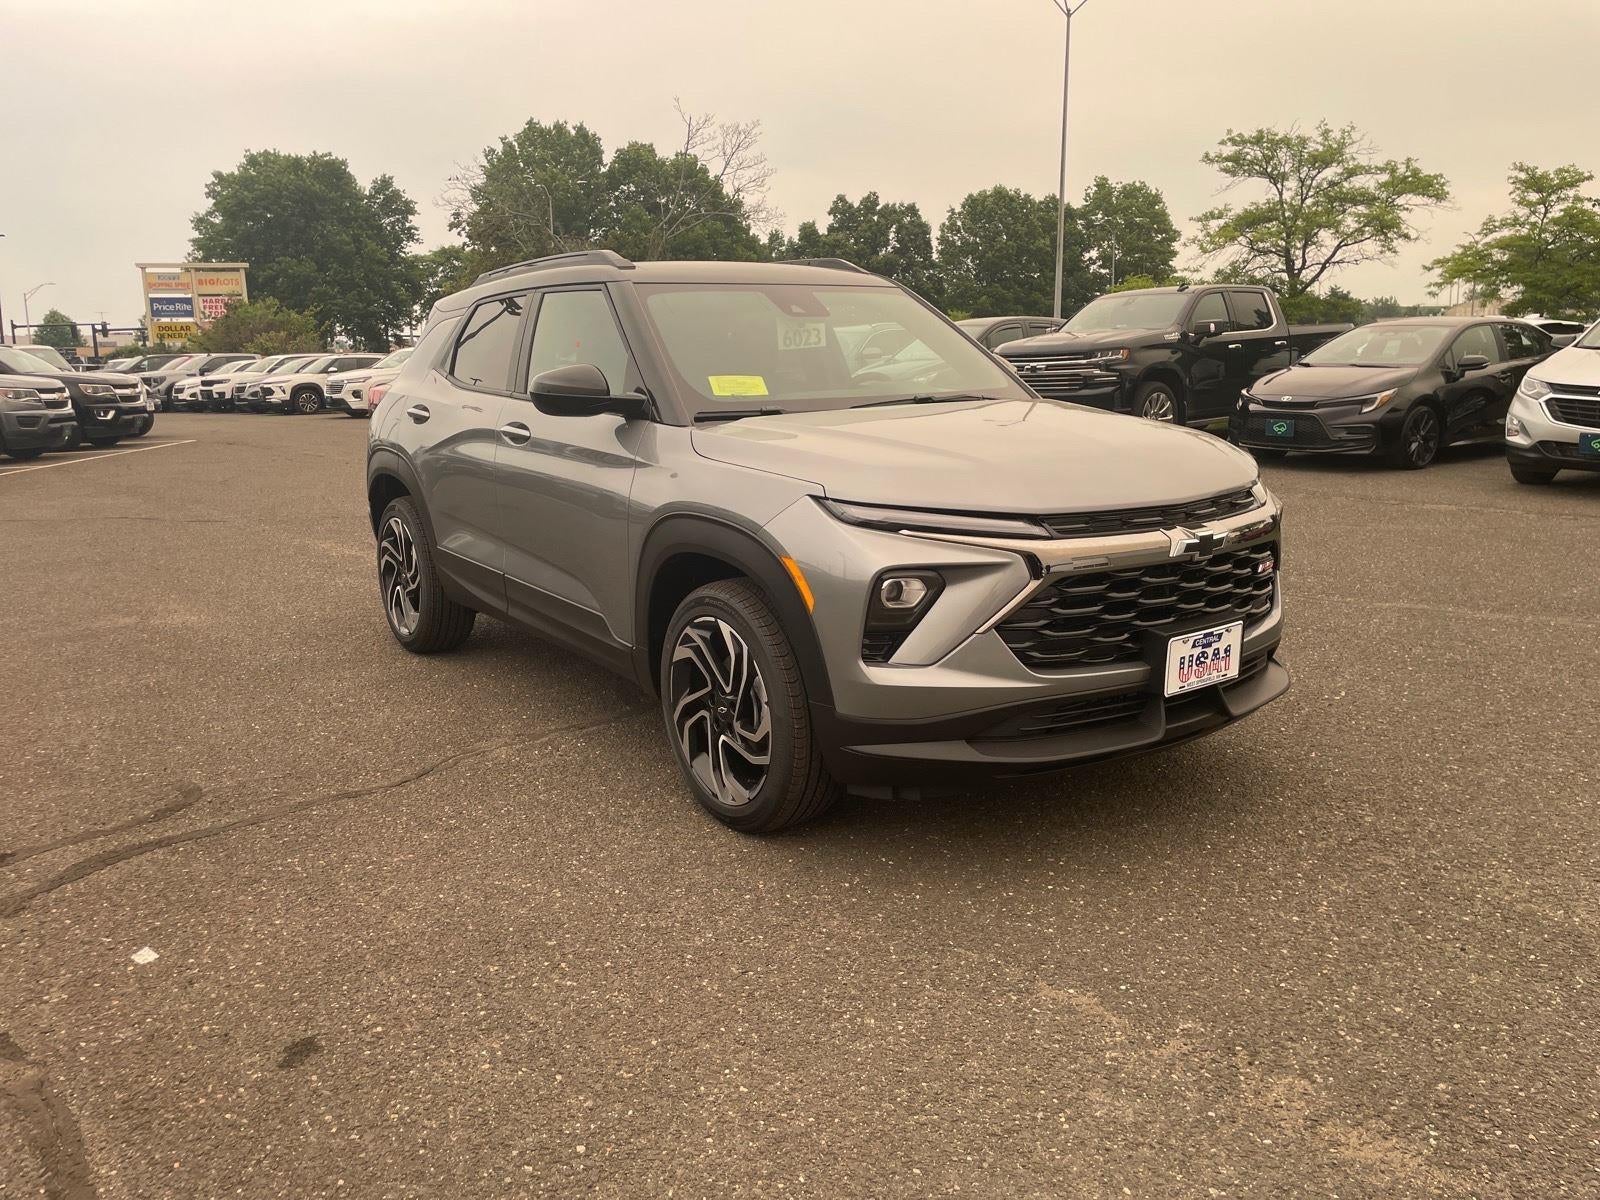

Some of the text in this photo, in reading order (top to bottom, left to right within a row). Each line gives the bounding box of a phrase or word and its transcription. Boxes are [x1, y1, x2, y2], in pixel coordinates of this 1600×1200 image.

[153, 303, 192, 311] Price Rite
[783, 328, 822, 347] 6023
[1195, 634, 1220, 647] CENTRAL
